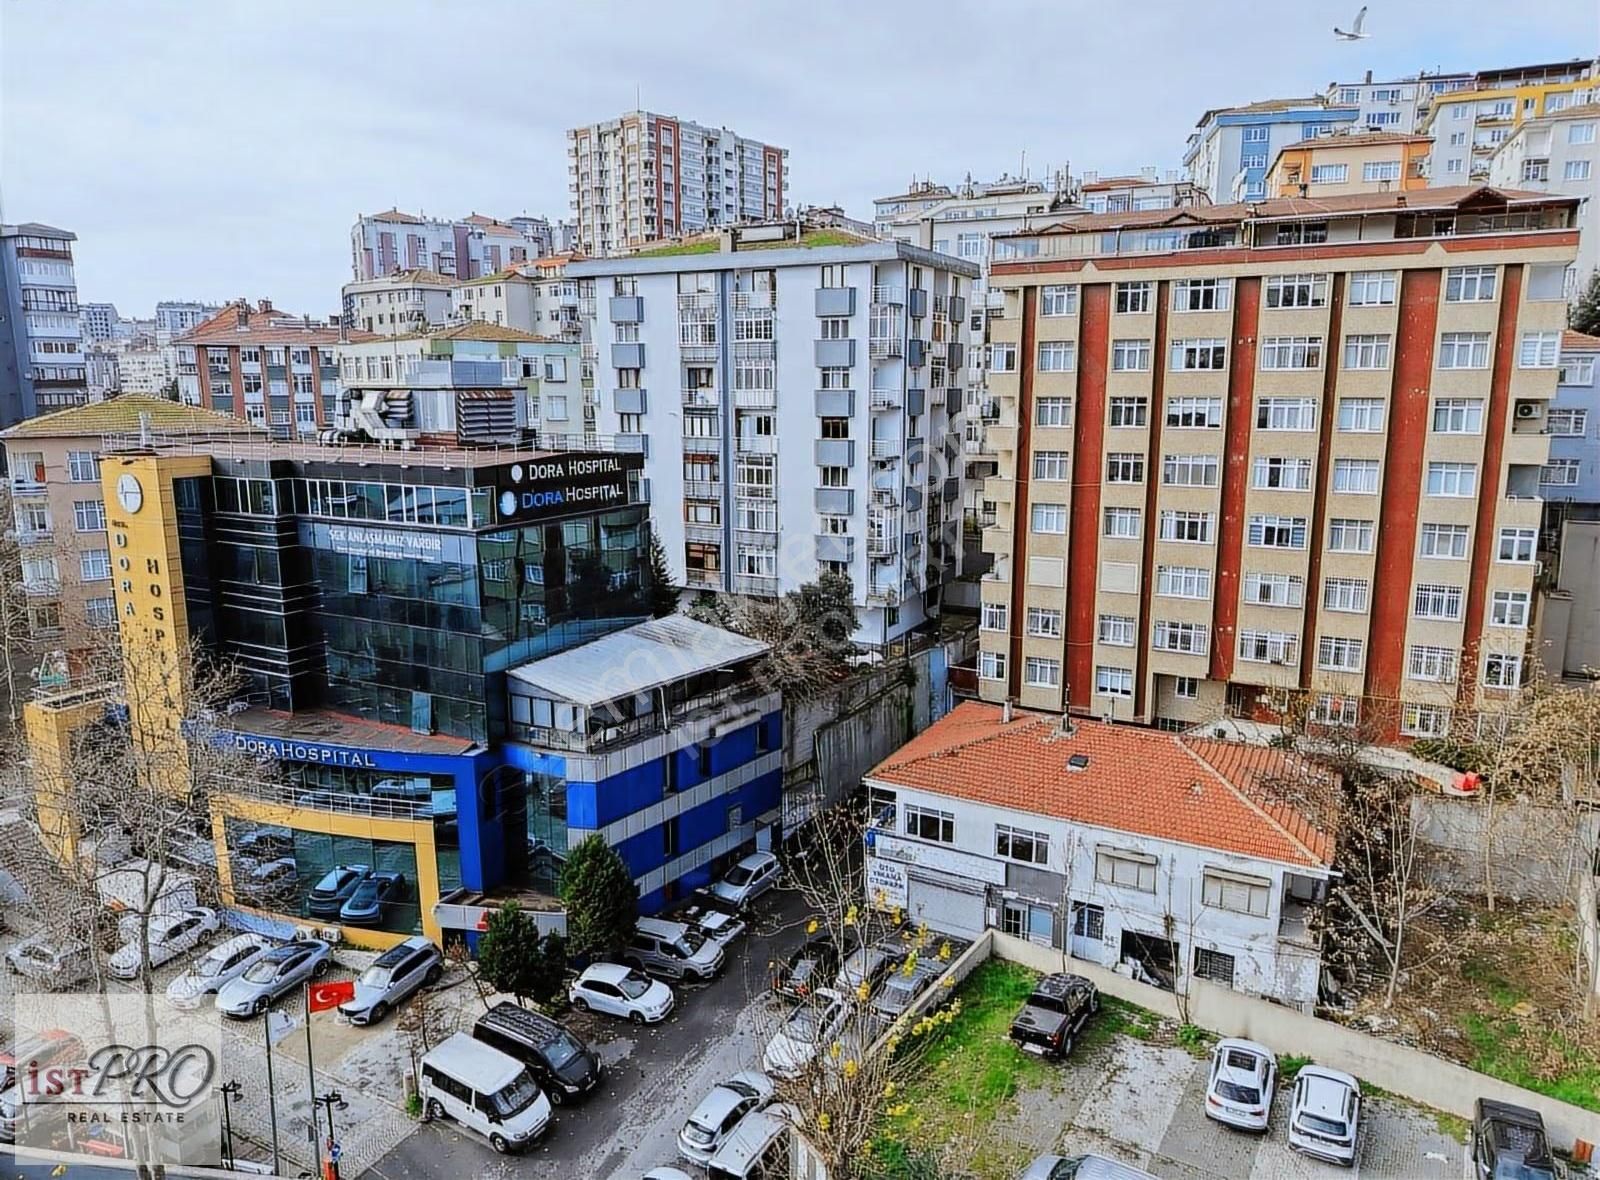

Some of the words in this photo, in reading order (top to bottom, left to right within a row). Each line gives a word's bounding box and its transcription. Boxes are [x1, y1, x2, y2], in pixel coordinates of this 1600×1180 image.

[529, 464, 565, 480] DORA
[568, 457, 622, 476] HOSPITAL
[522, 490, 564, 509] DORA
[565, 483, 624, 502] HOSPITAL
[113, 533, 136, 617] DORA
[236, 736, 280, 756] DORA
[281, 743, 376, 767] HOSPITAL
